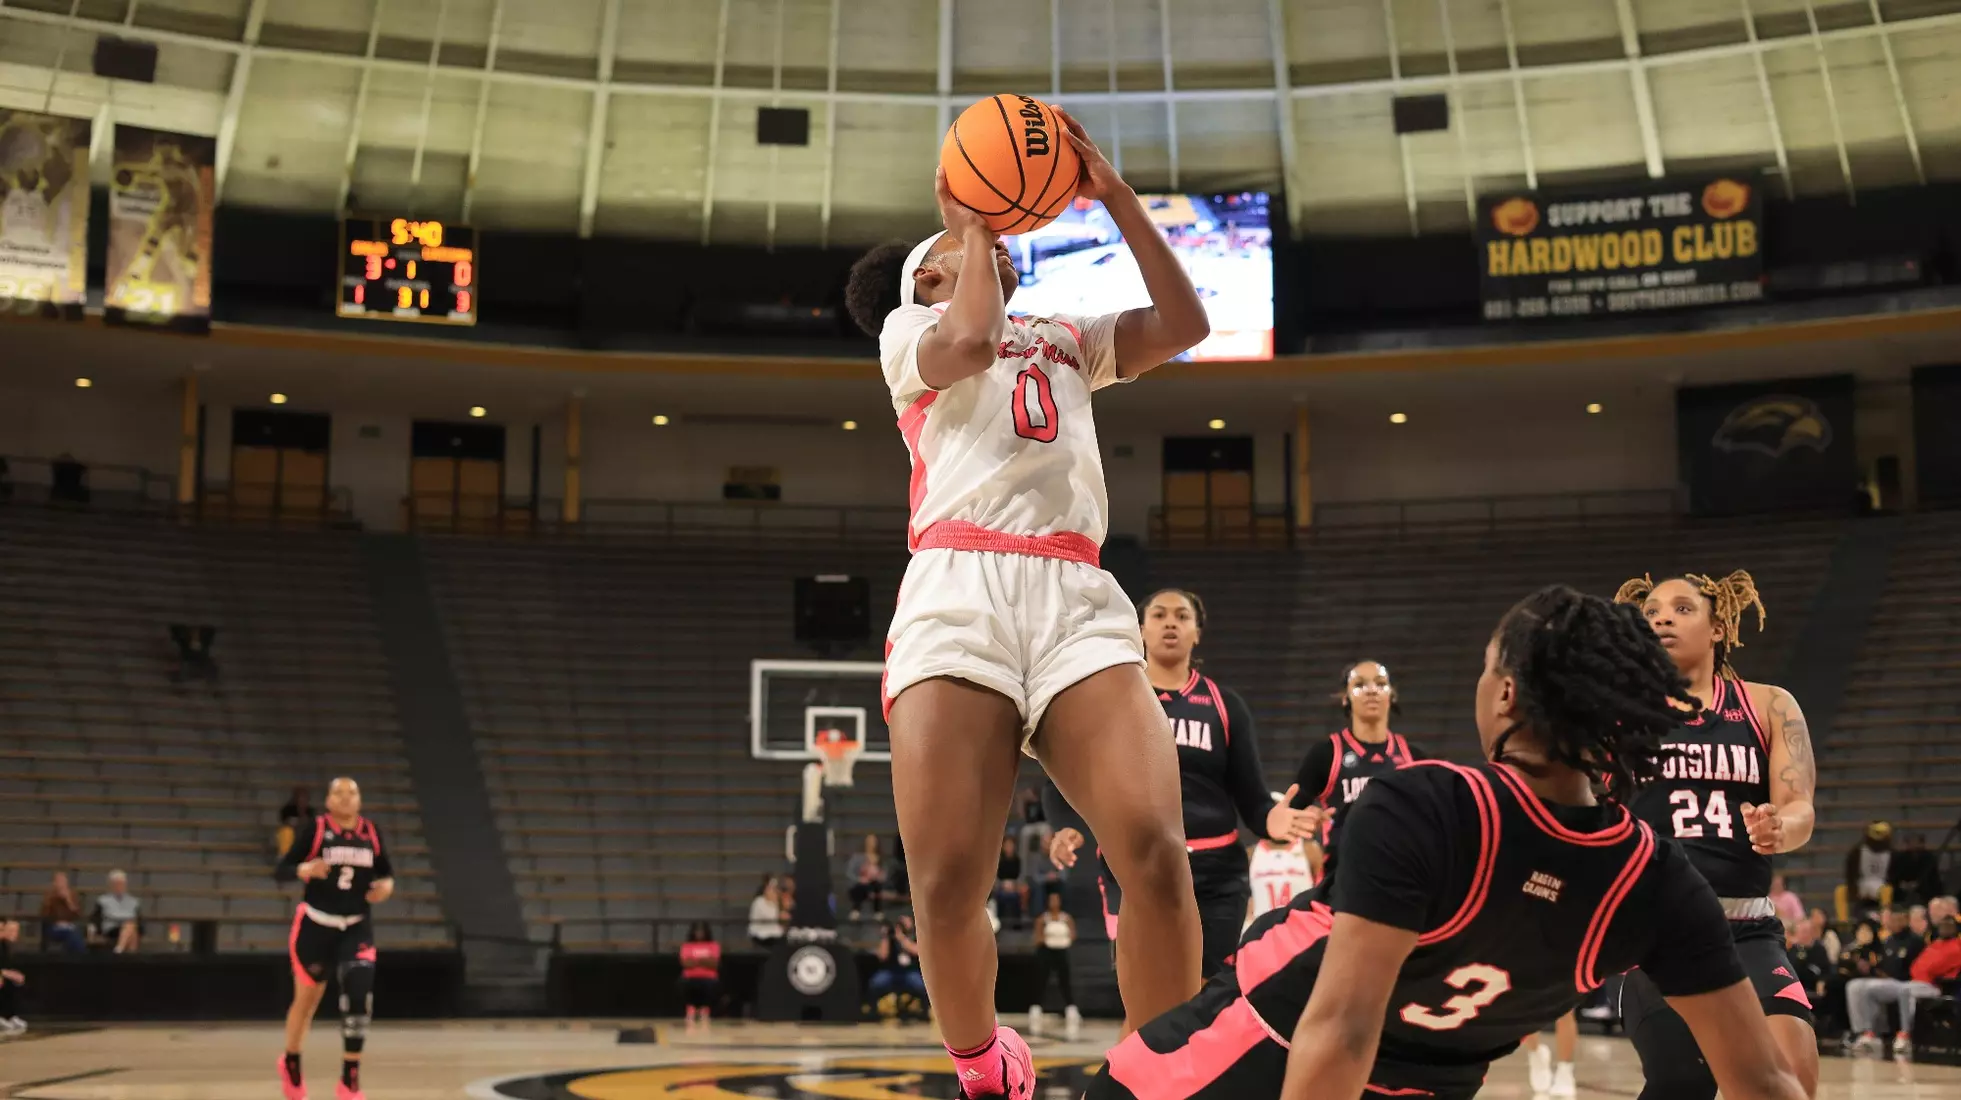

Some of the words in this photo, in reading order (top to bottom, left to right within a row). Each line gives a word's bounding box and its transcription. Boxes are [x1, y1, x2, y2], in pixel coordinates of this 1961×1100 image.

[1548, 196, 1645, 228] SUPPORT
[1647, 192, 1693, 218] THE
[391, 218, 442, 248] 5:40
[1487, 228, 1663, 277] HARDWOOD
[1672, 220, 1758, 264] CLUB
[454, 261, 472, 287] 0
[1011, 363, 1059, 443] 0
[1668, 789, 1734, 839] 24
[338, 867, 354, 890] 2
[1399, 962, 1512, 1031] 3
